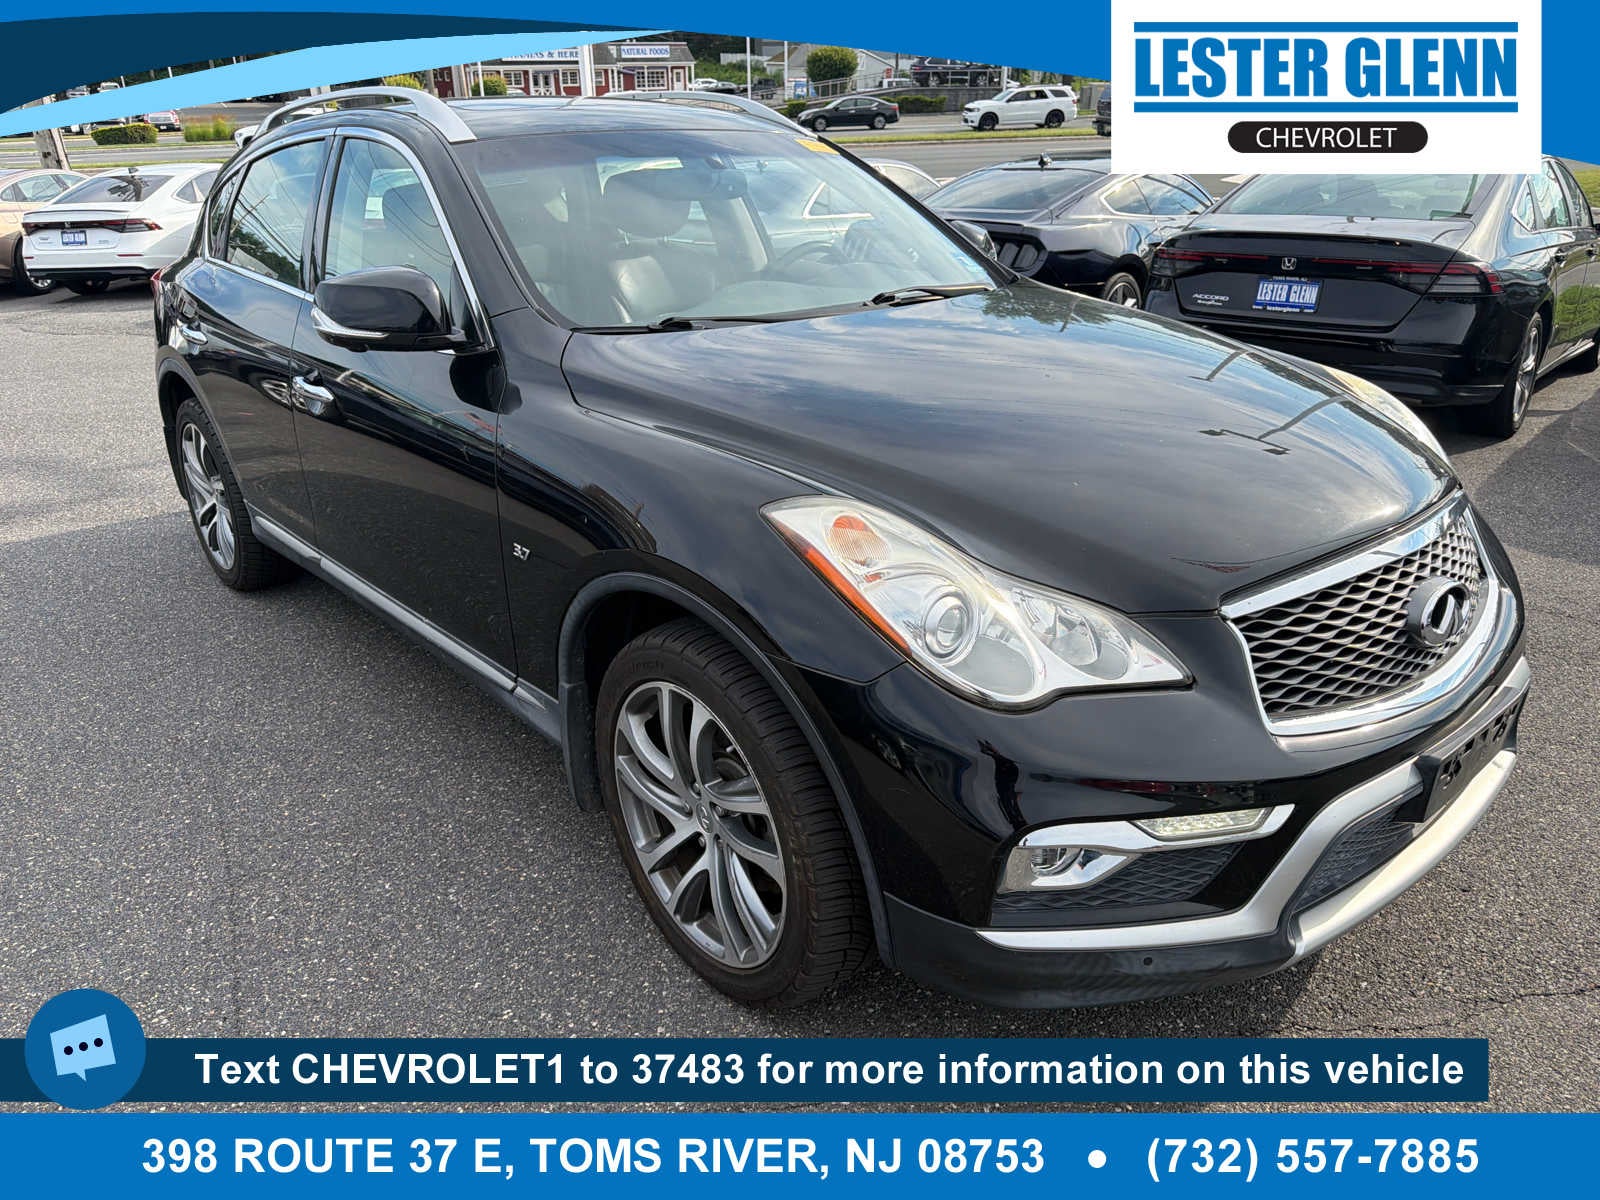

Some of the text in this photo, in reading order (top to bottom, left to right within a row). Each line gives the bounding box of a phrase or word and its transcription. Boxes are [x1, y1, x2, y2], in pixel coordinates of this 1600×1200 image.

[622, 47, 669, 56] NATURAL FOODS
[1192, 293, 1230, 301] ACCORD
[1257, 281, 1319, 304] LESTER GLENN
